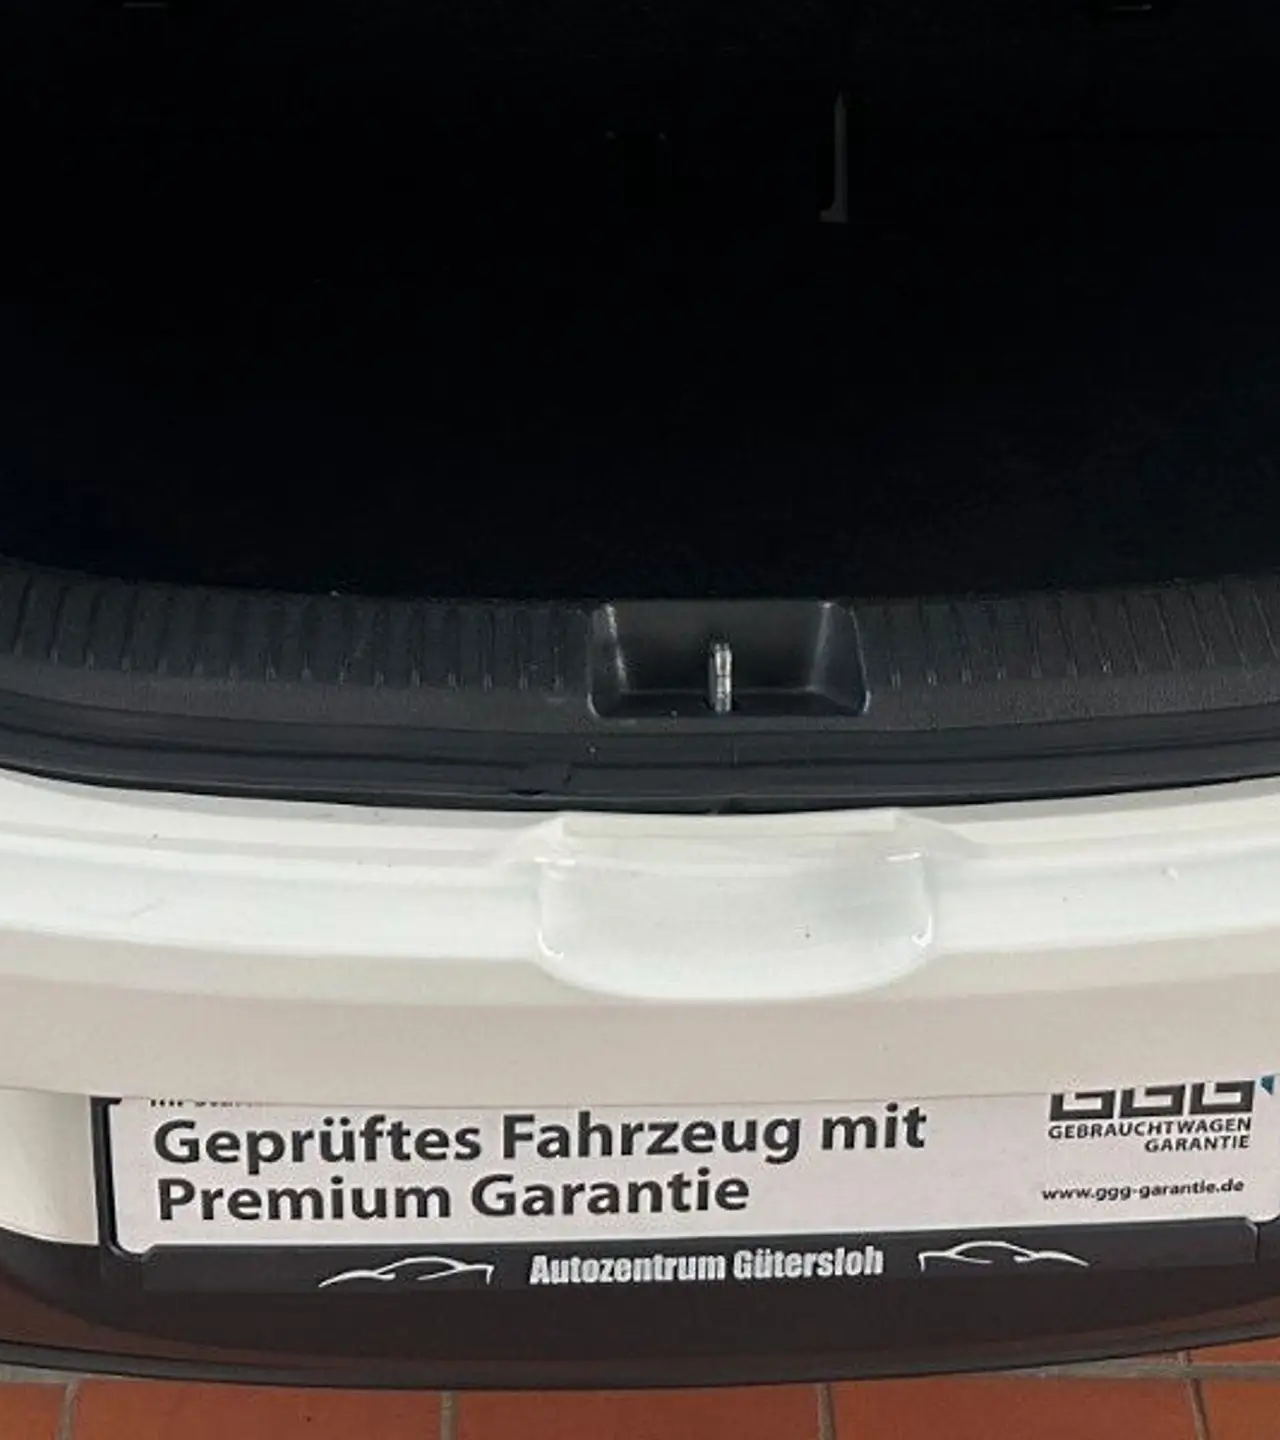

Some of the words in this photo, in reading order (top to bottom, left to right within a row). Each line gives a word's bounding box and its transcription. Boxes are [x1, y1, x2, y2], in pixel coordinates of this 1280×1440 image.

[154, 1115, 483, 1174] Geprüftes
[503, 1110, 801, 1164] Fahrzeug
[821, 1102, 927, 1150] mit
[1048, 1117, 1252, 1140] GEBRAUCHTWAGEN
[1144, 1134, 1251, 1153] GARANTIE
[158, 1176, 452, 1221] Premium
[471, 1166, 750, 1218] Garantie
[1041, 1178, 1245, 1202] www.ggg-garantie.de
[529, 1254, 727, 1285] Autozentrum
[732, 1245, 885, 1280] Gütersloh
